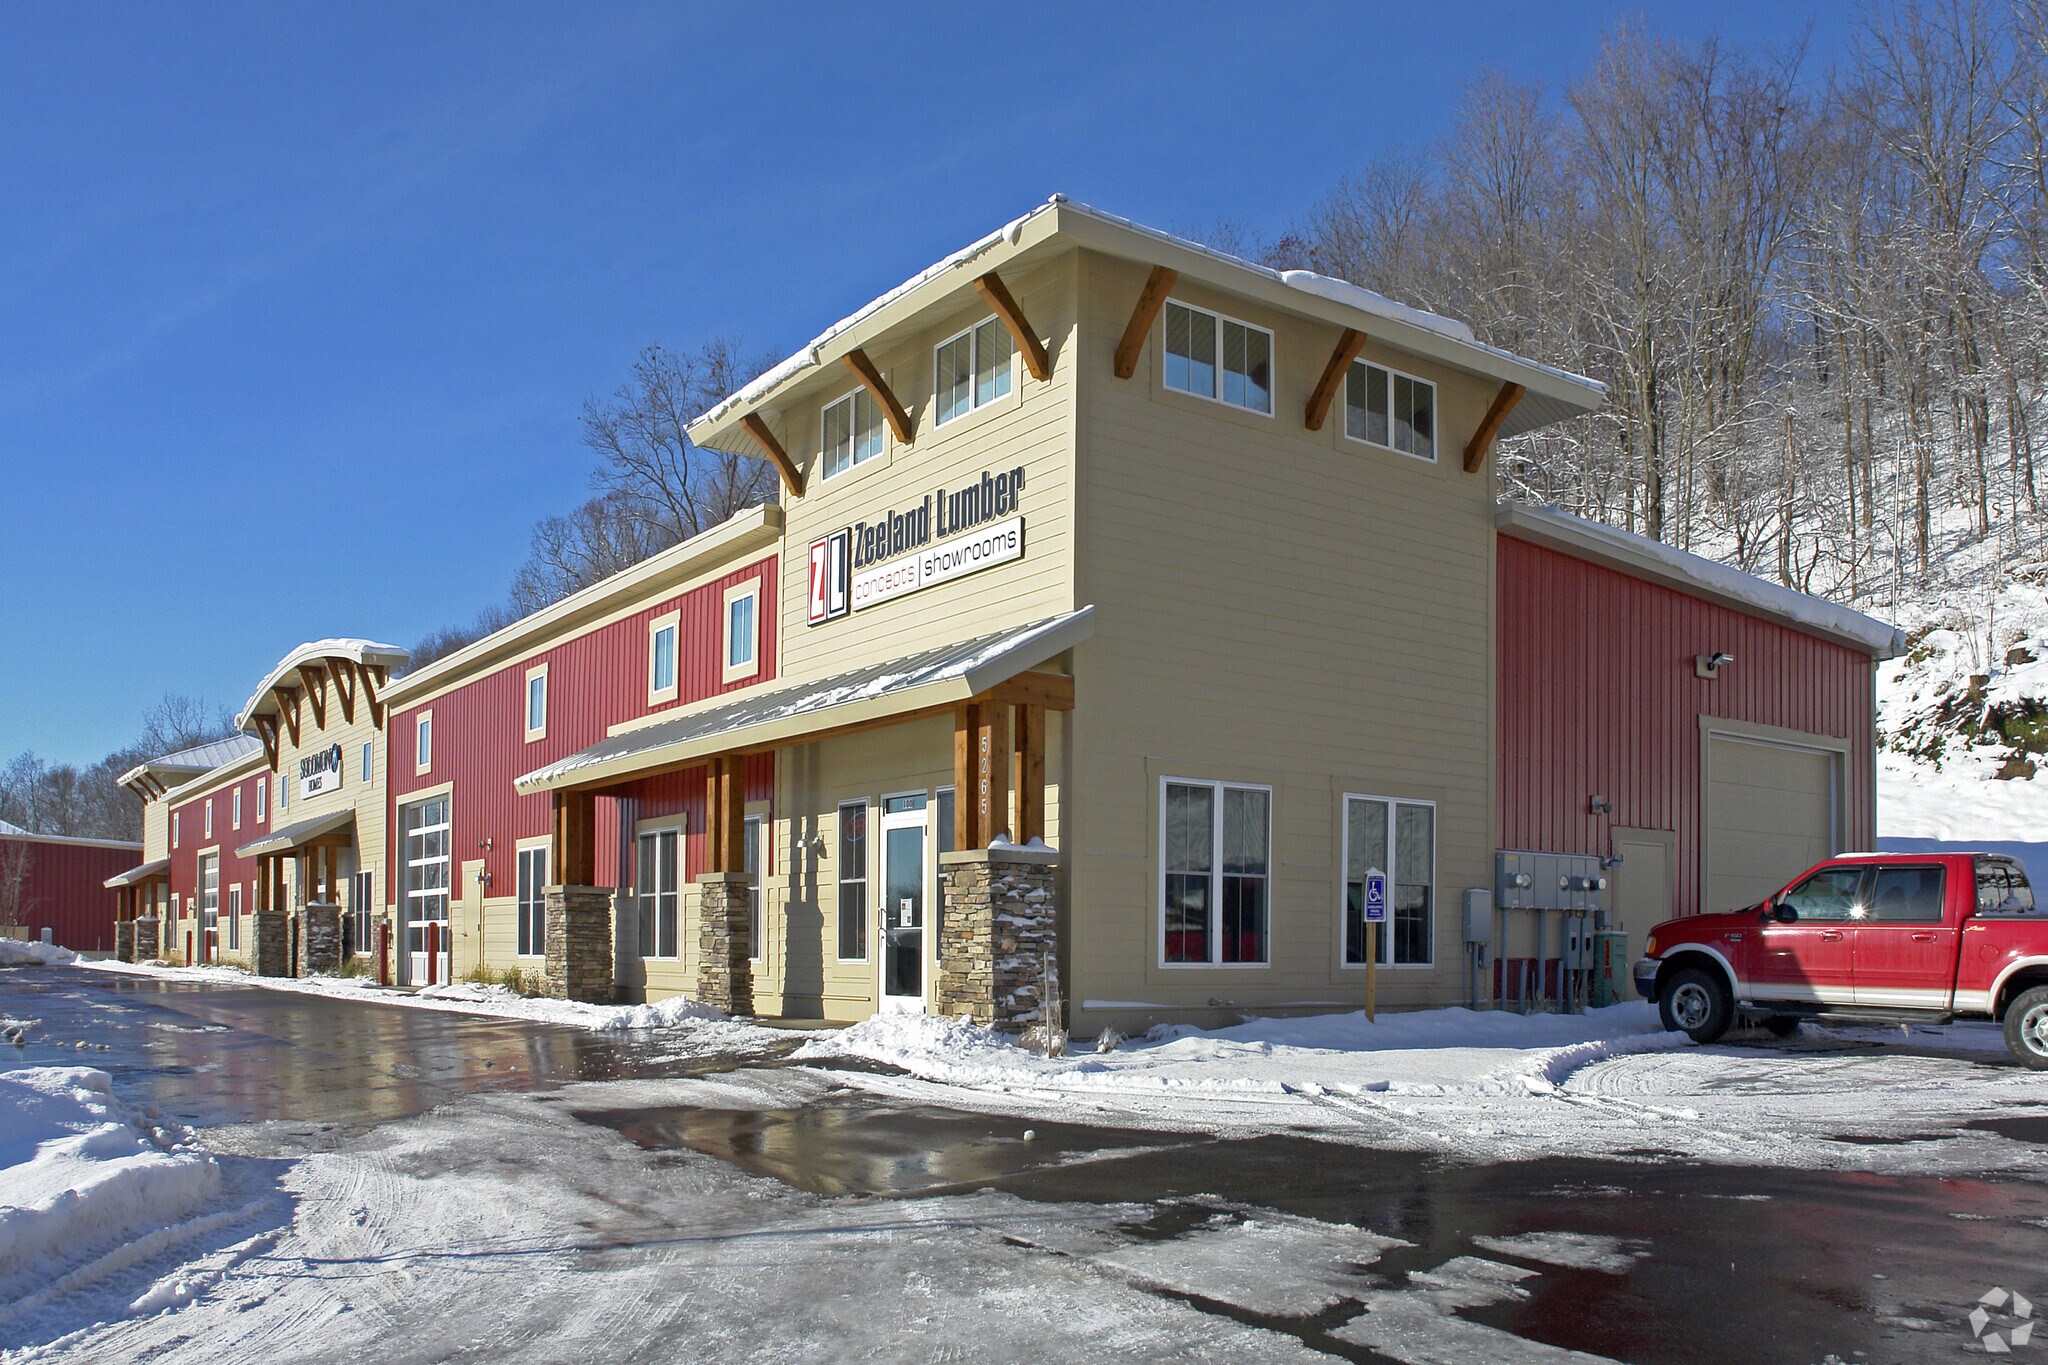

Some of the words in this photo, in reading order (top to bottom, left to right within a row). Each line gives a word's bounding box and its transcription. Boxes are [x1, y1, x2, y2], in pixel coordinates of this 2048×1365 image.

[854, 495, 932, 569] Zeeland
[936, 466, 1025, 539] Lumber
[855, 564, 915, 600] concepts
[924, 530, 1017, 577] showrooms
